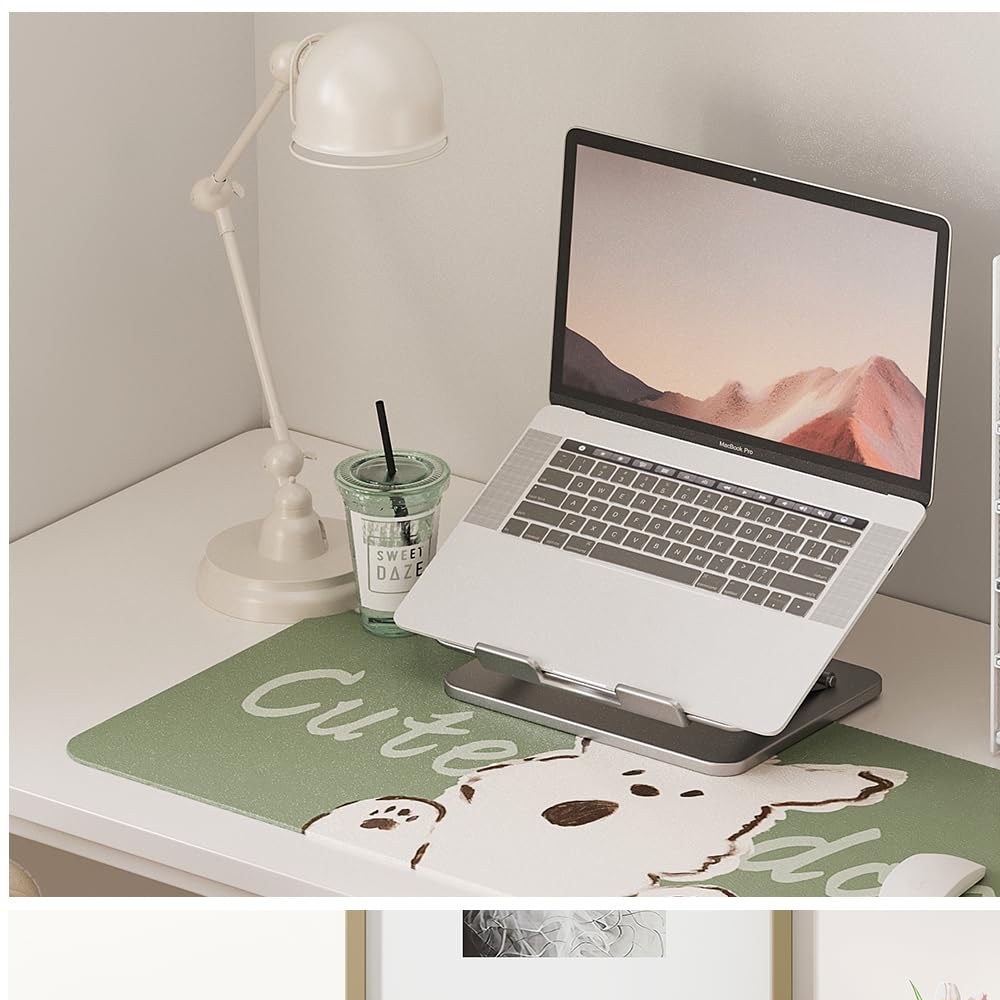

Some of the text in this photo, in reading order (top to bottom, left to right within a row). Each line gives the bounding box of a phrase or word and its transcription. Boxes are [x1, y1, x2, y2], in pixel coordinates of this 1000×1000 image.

[720, 440, 743, 452] MacBook
[376, 546, 423, 561] SWEET
[241, 668, 518, 777] Cute
